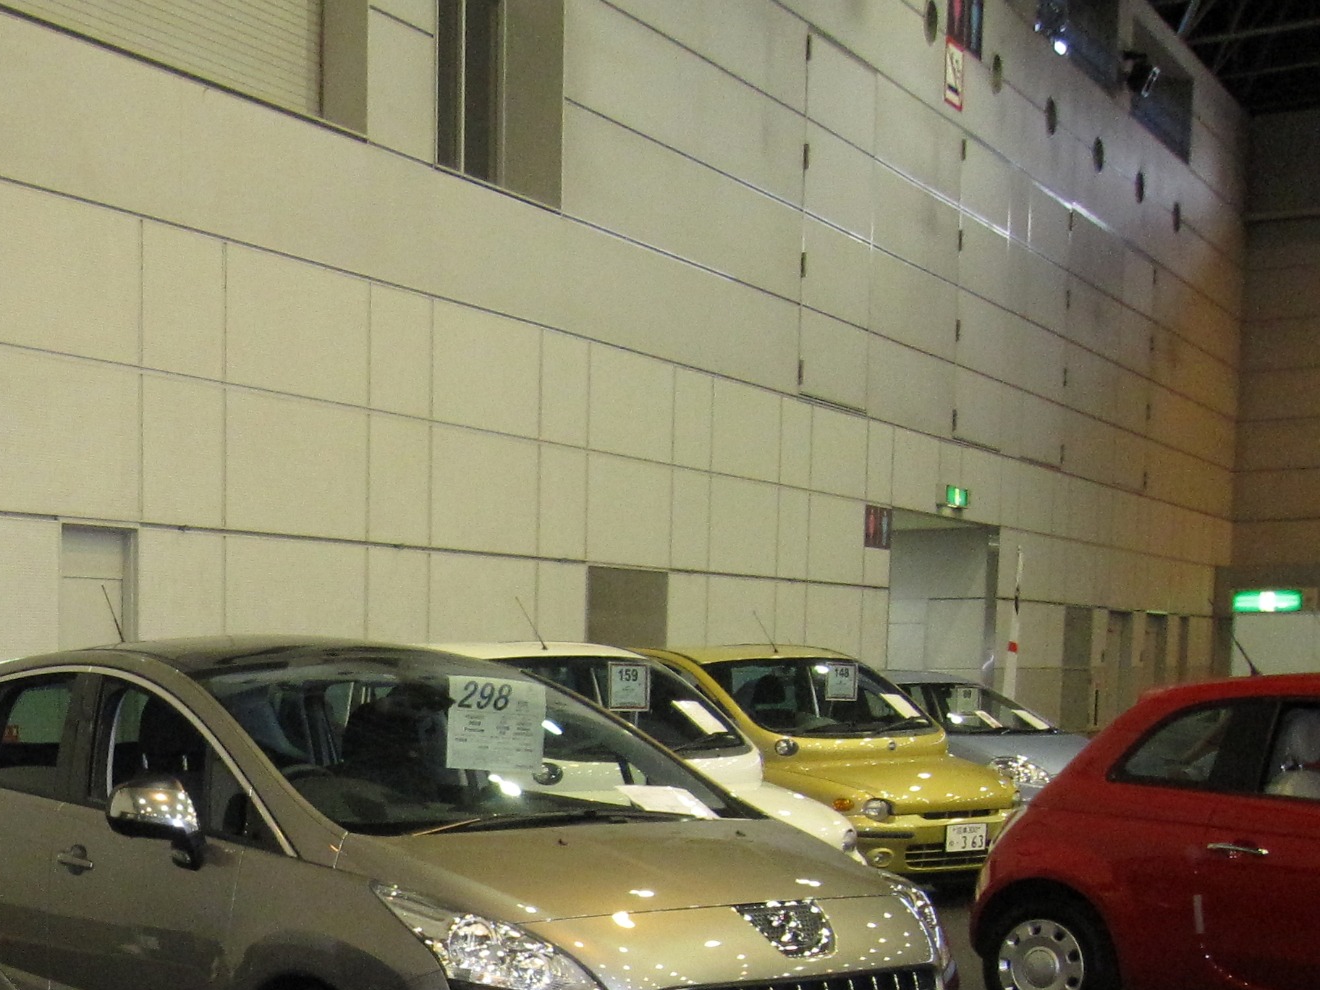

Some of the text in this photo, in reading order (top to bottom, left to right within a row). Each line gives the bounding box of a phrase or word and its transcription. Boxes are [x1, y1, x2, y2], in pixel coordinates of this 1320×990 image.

[618, 668, 639, 682] 159
[834, 667, 850, 678] 148
[457, 680, 513, 711] 298
